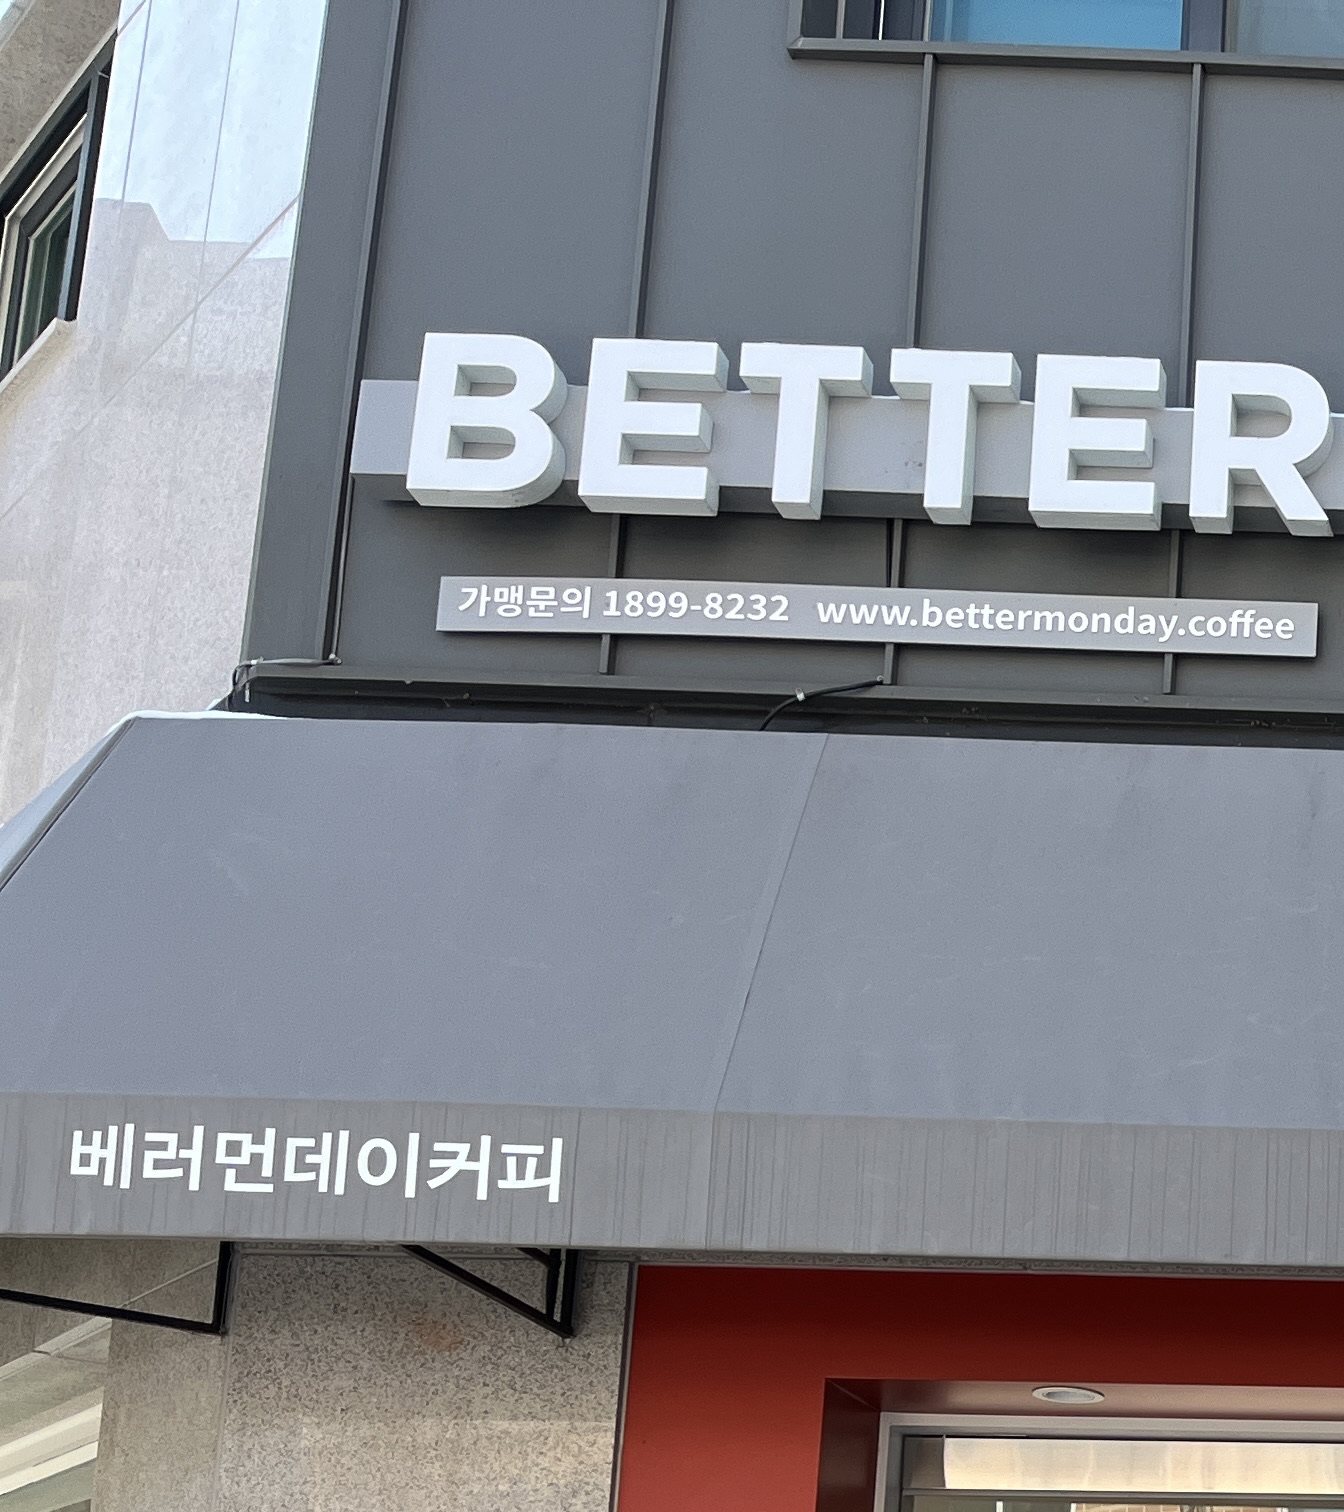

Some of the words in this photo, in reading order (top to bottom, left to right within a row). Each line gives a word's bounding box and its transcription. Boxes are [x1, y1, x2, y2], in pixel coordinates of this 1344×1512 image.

[406, 333, 1334, 536] BETTER
[458, 585, 592, 619] 가맹문의
[603, 589, 789, 622] 1899-8232
[817, 598, 1295, 642] www.bettermonday.coffee
[70, 1123, 563, 1202] 베러먼데이커피
